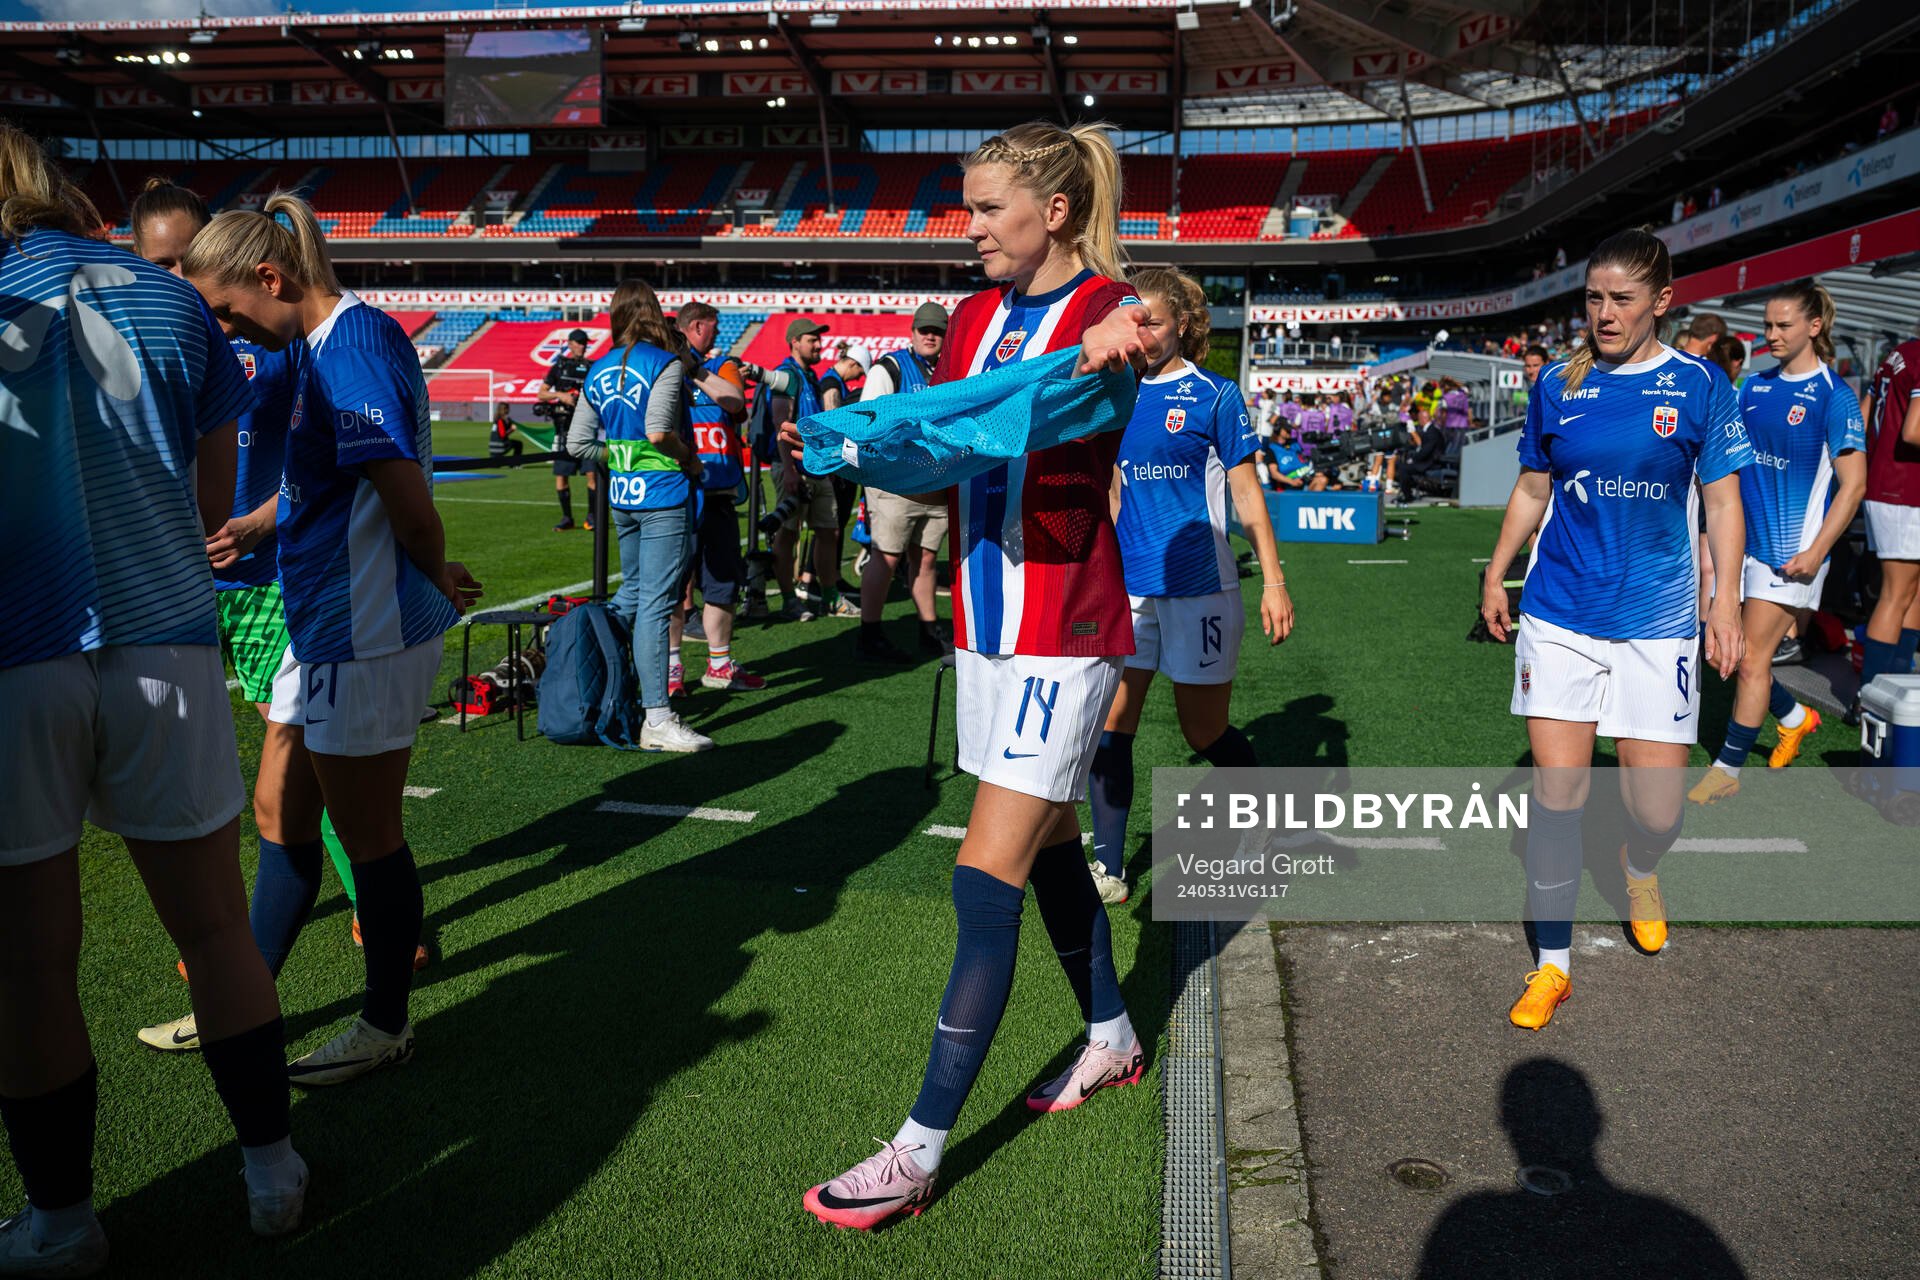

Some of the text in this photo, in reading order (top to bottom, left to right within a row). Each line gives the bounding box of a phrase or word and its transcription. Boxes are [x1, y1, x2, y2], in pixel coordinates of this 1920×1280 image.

[199, 85, 265, 103] VG
[732, 74, 804, 93] VG
[844, 71, 914, 91] VG
[968, 73, 1039, 90] VG
[1074, 73, 1154, 90] VG
[1219, 63, 1293, 87] VG
[669, 128, 842, 146] VG VG
[385, 292, 419, 302] VG
[427, 292, 462, 302] VG
[470, 292, 505, 302] VG
[512, 293, 549, 302] VG
[556, 294, 592, 303] VG
[692, 294, 729, 304] VG
[738, 294, 776, 304] VG
[784, 294, 822, 304] VG
[832, 294, 870, 304] VG
[880, 295, 918, 305] VG
[1253, 309, 1297, 321] VG
[1301, 308, 1344, 320] VG
[1347, 308, 1388, 320] VG
[1391, 305, 1428, 320] VG
[1431, 303, 1462, 318] VG
[1257, 376, 1358, 389] VG VG
[1662, 389, 1687, 398] Tipping
[341, 402, 385, 433] DNB
[609, 444, 633, 472] TV
[1753, 450, 1791, 471] elenor
[1133, 461, 1191, 481] telenor
[610, 476, 646, 505] 029
[1596, 475, 1670, 500] telenor
[1298, 507, 1356, 531] NRK
[1200, 616, 1221, 656] 15
[1676, 656, 1689, 704] 6
[1015, 676, 1060, 745] 14
